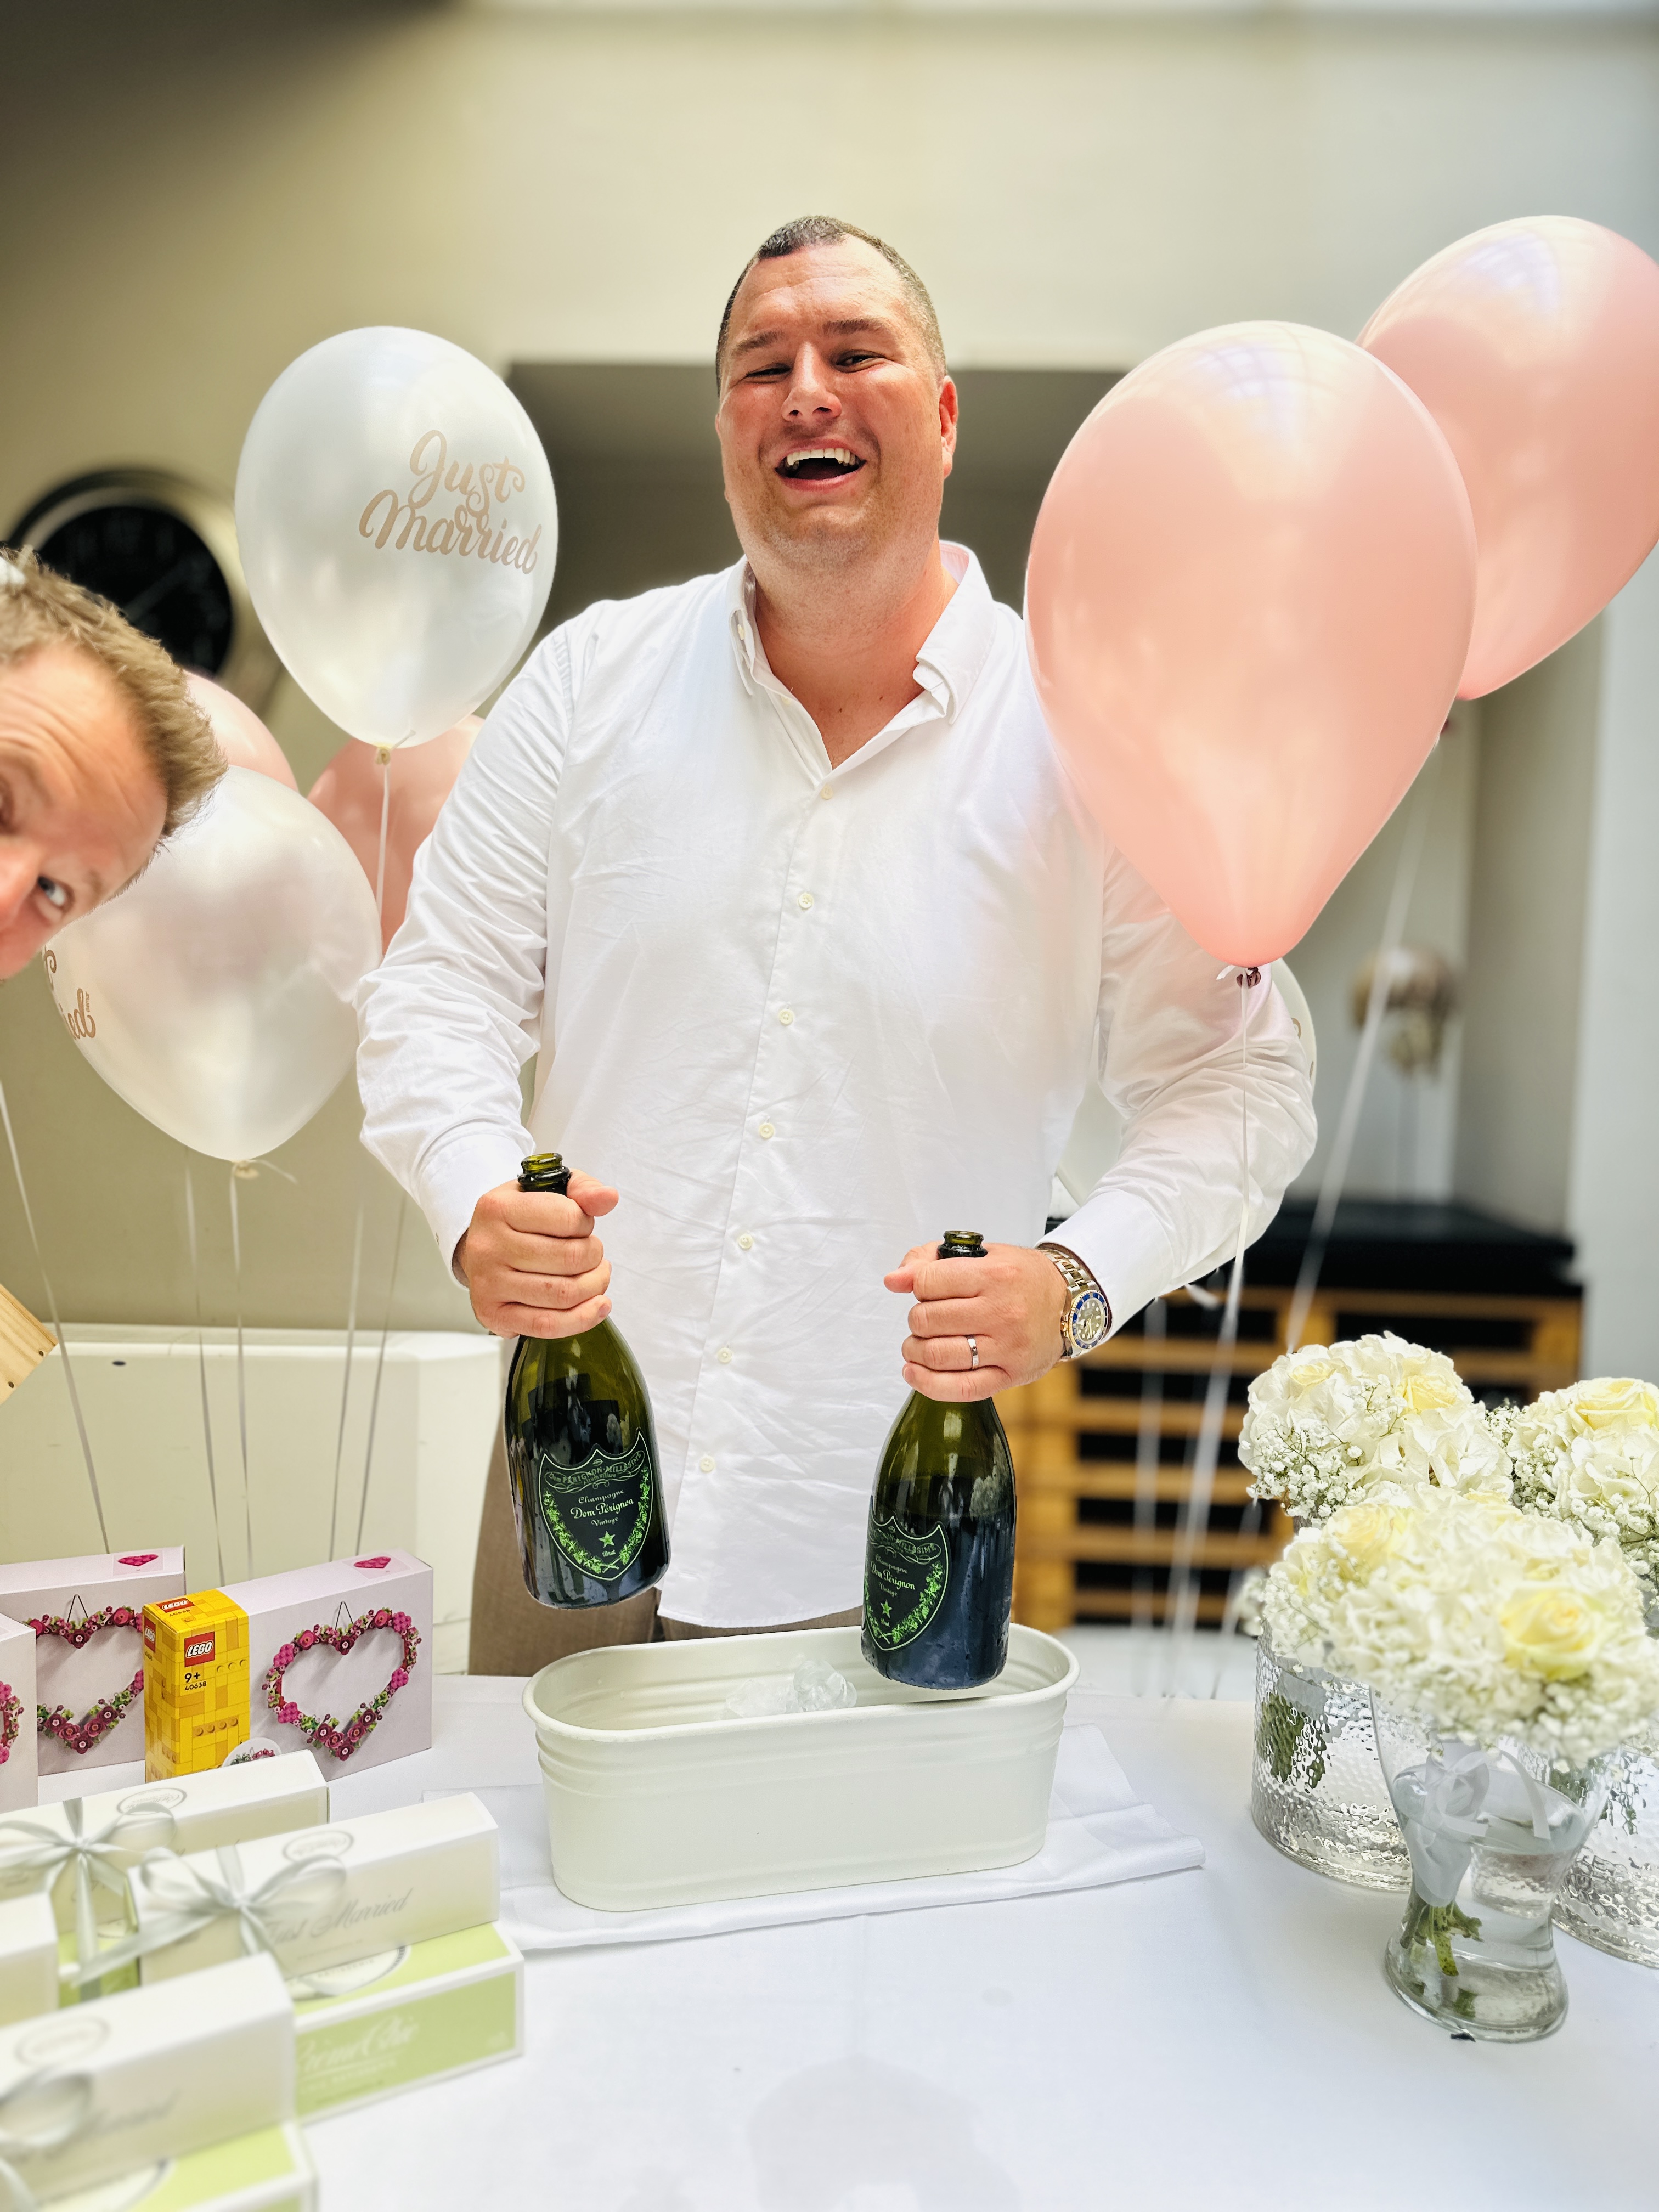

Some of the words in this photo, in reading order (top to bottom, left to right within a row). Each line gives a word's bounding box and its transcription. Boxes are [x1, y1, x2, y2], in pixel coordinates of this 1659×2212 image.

[408, 430, 525, 518] Just
[359, 489, 542, 574] Married
[578, 1489, 625, 1505] Champagne
[569, 1506, 596, 1519] Dom
[595, 1498, 634, 1516] Pérignon
[591, 1516, 619, 1527] Vintage
[602, 1549, 616, 1558] Brut
[163, 1599, 188, 1610] LEGO
[187, 1640, 213, 1658] LEGO
[184, 1672, 201, 1683] 9+
[184, 1680, 207, 1691] 40638
[310, 1887, 413, 1938] Married
